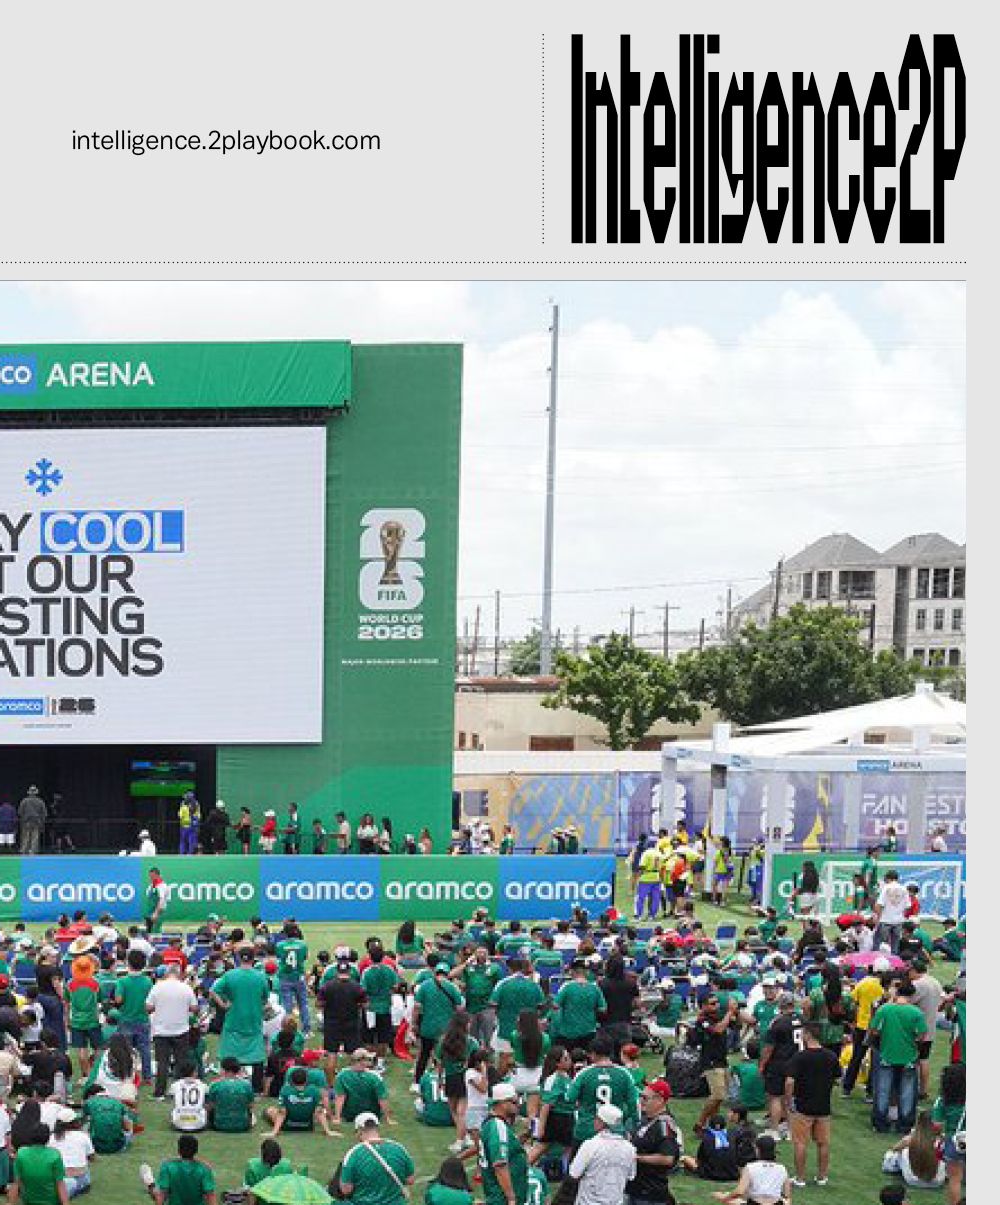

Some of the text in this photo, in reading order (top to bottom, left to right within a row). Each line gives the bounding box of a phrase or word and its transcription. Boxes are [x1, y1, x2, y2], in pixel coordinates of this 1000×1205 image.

[46, 361, 155, 387] ARENA
[44, 512, 181, 551] COOL
[26, 554, 136, 594] OUR
[377, 590, 407, 601] FIFA
[359, 613, 424, 624] WORLD CUP
[357, 624, 424, 640] 2026
[863, 793, 907, 815] FAN
[26, 881, 136, 902] aramco
[145, 881, 255, 902] ramco
[264, 881, 375, 901] aramco
[385, 881, 494, 901] aramco
[504, 881, 612, 901] aramco
[285, 950, 298, 968] 4
[180, 1087, 199, 1107] 10
[596, 1085, 612, 1107] 9
